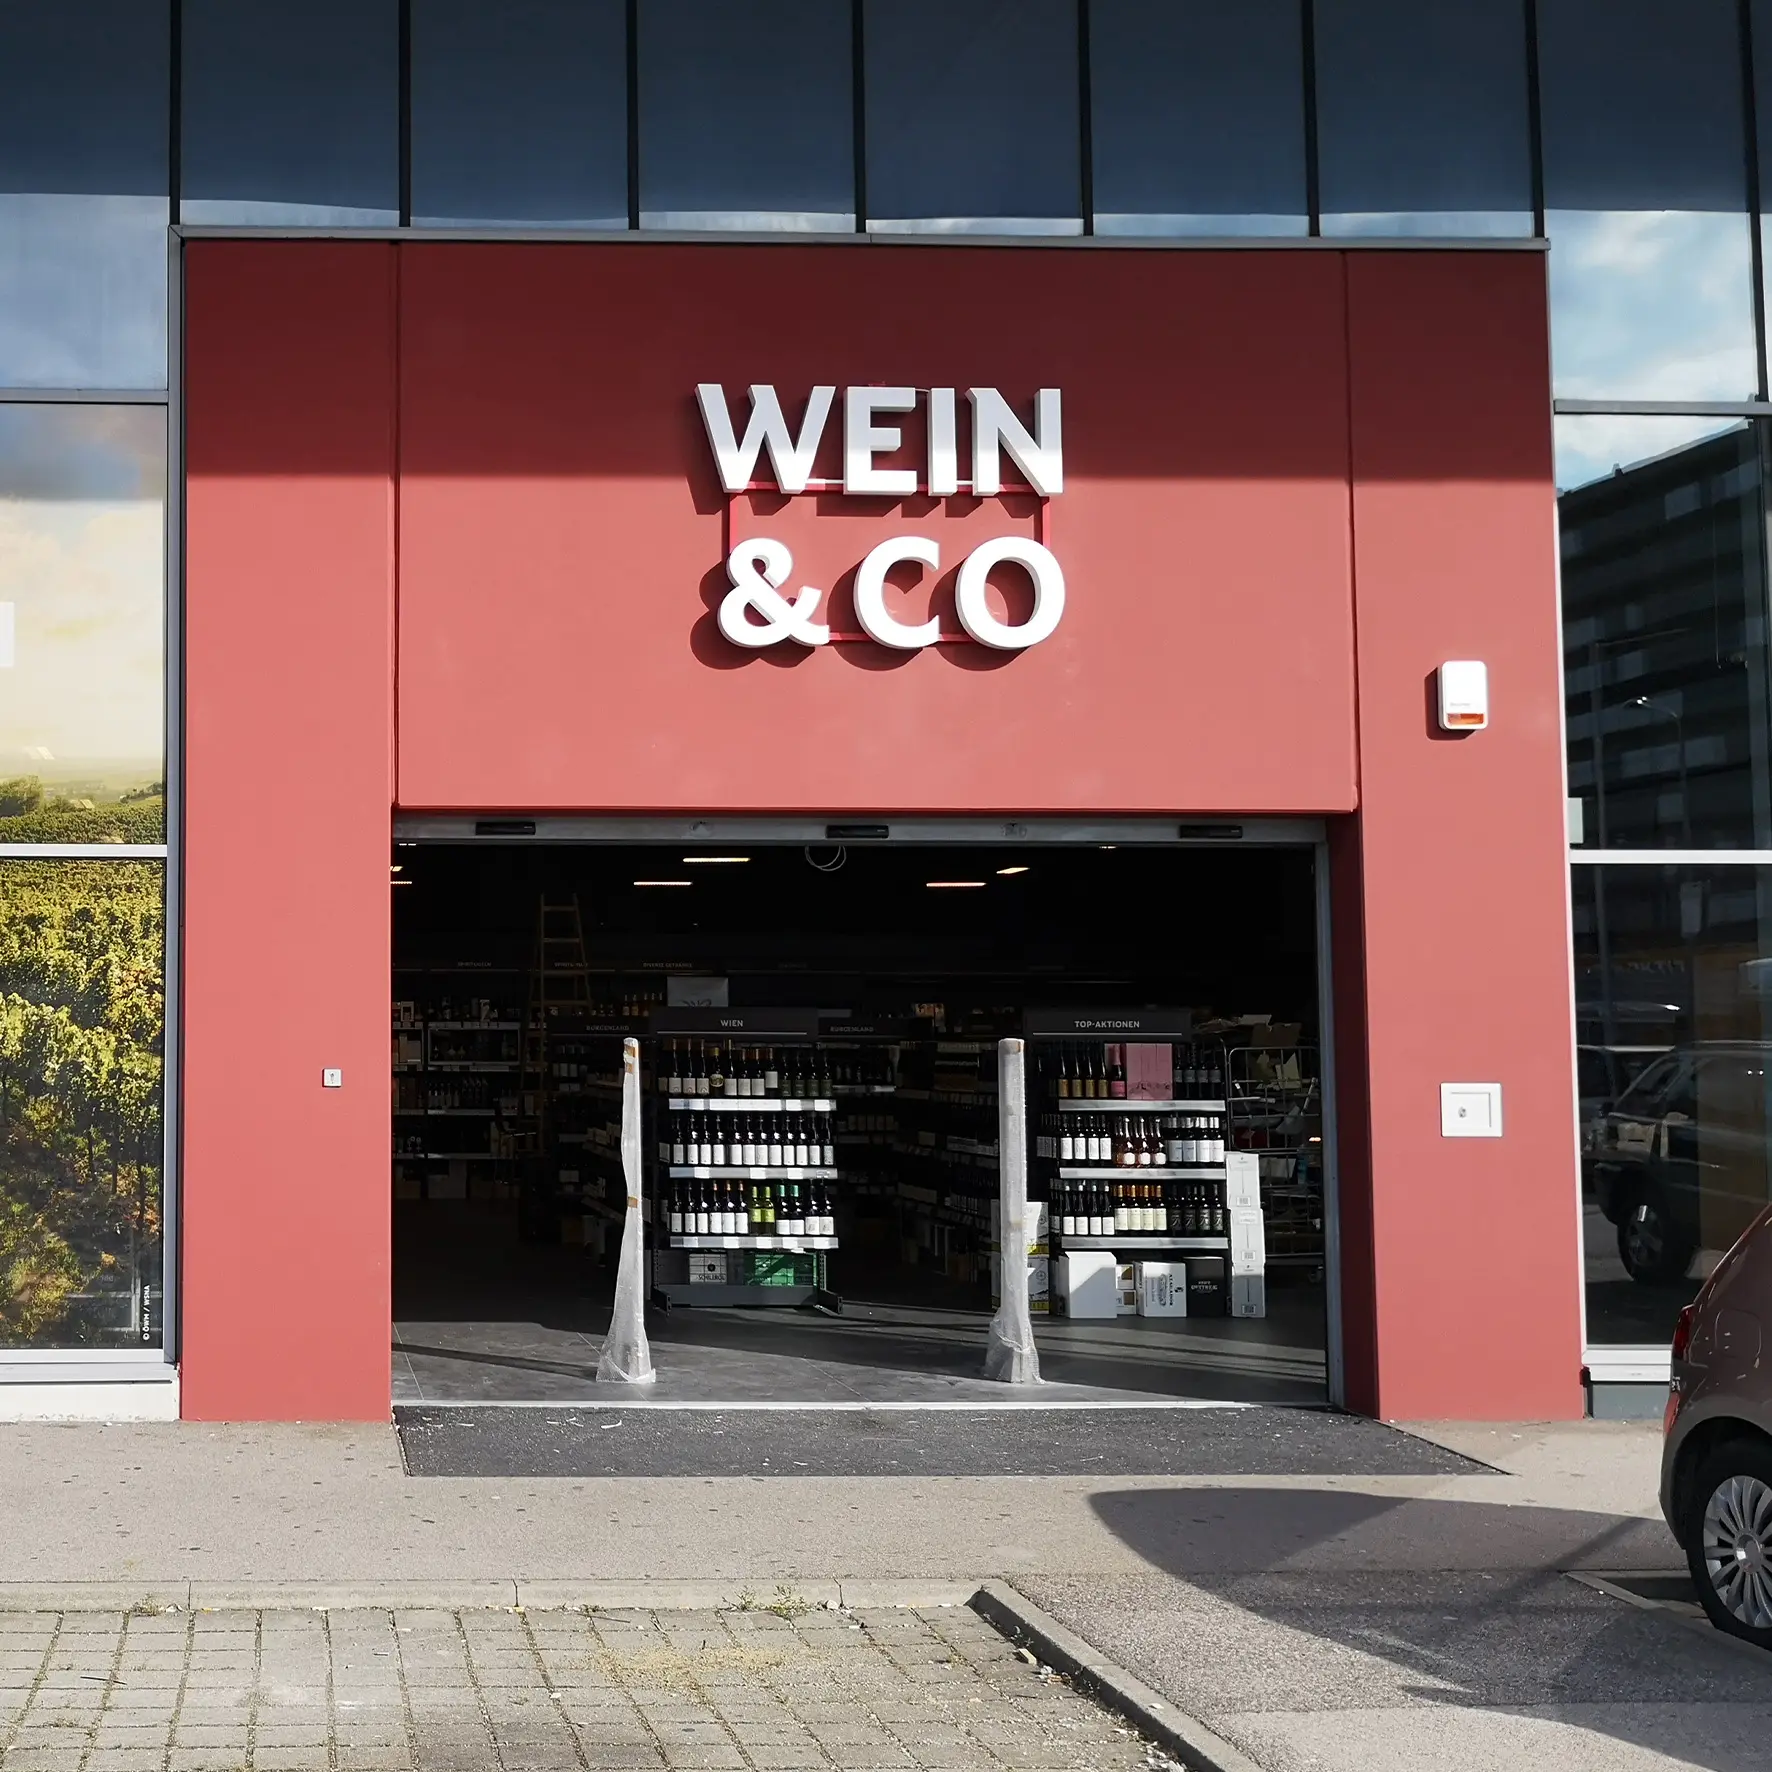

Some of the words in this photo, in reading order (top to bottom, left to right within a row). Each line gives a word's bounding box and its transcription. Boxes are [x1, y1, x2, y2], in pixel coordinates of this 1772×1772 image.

[695, 384, 1063, 496] WEIN
[720, 1019, 744, 1028] WIEN
[1074, 1020, 1140, 1028] TOP-AKTIONEN
